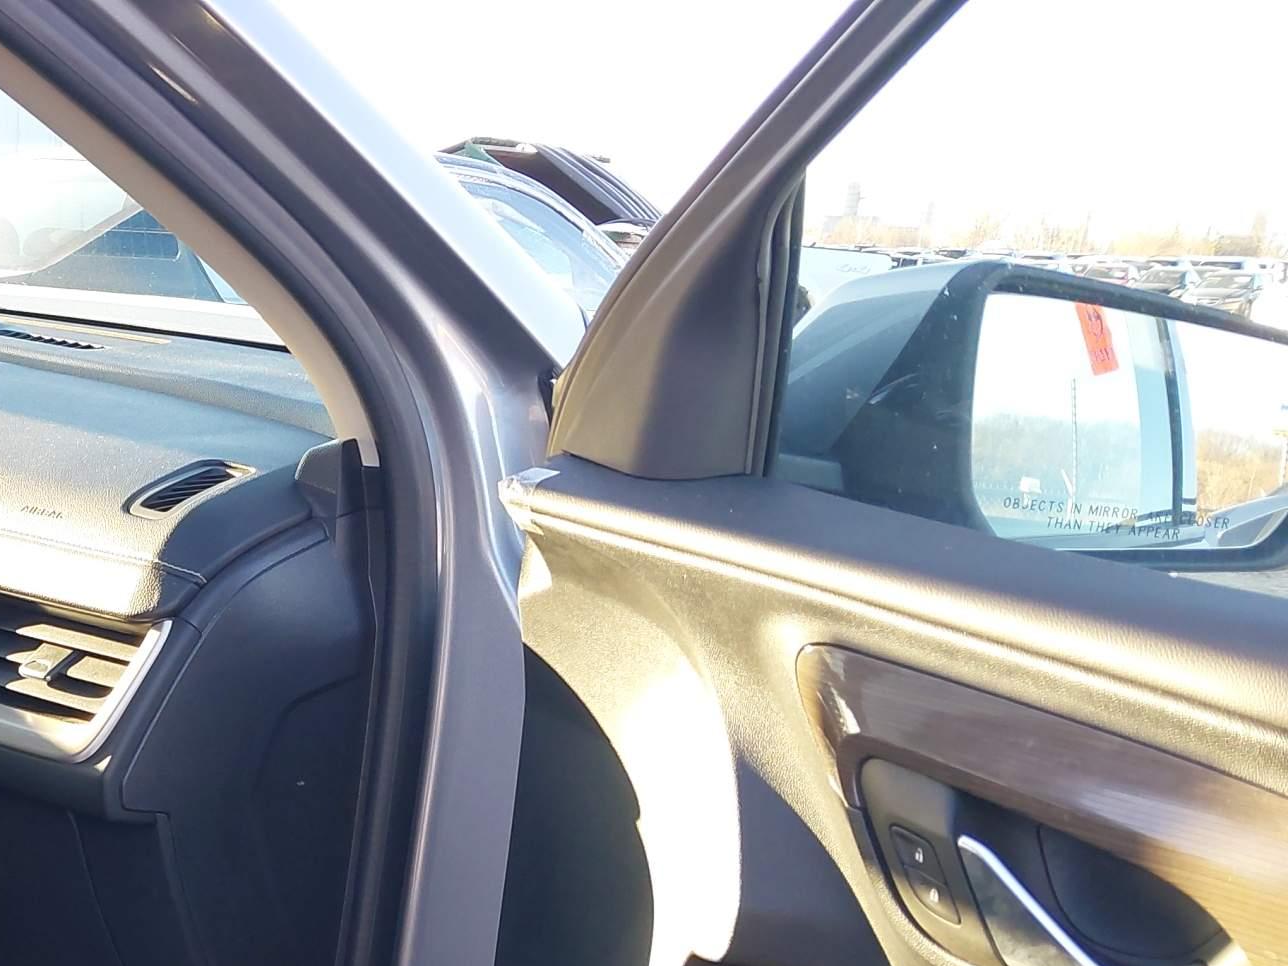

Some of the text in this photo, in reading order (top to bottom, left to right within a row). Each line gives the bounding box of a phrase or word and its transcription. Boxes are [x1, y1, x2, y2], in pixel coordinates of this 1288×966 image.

[1003, 497, 1230, 529] OBJECTS IN MIRROR ARE CLOSER
[1047, 516, 1180, 540] THAN THEY APPEAR
